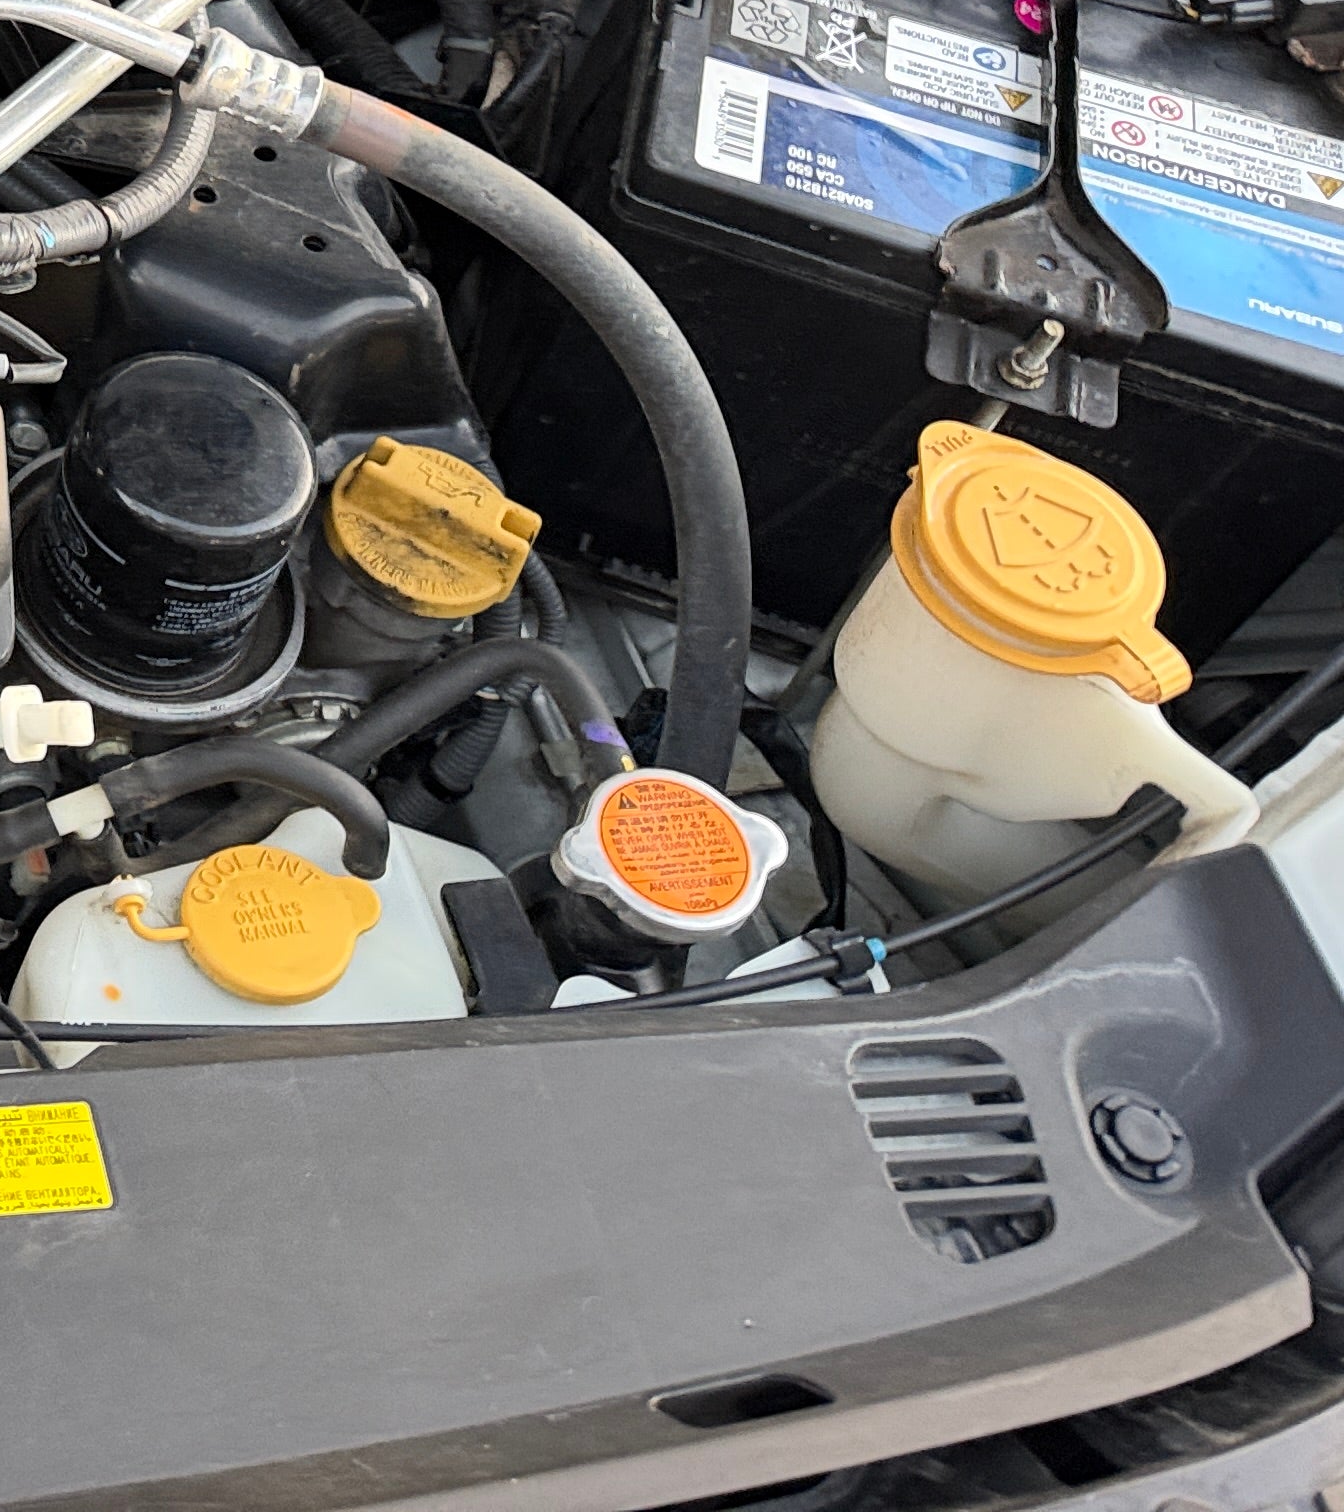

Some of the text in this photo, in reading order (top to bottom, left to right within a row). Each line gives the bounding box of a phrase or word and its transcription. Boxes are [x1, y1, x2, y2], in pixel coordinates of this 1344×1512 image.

[816, 151, 836, 169] RC
[815, 167, 844, 186] CCA
[1092, 142, 1286, 209] DANGER/POISON
[1247, 297, 1343, 334] SUBARU
[634, 790, 691, 803] WARNING
[191, 850, 320, 904] COOLANT
[647, 875, 734, 892] AVERTISSEMENT
[236, 888, 272, 908] SEE
[239, 919, 310, 943] MANUAL
